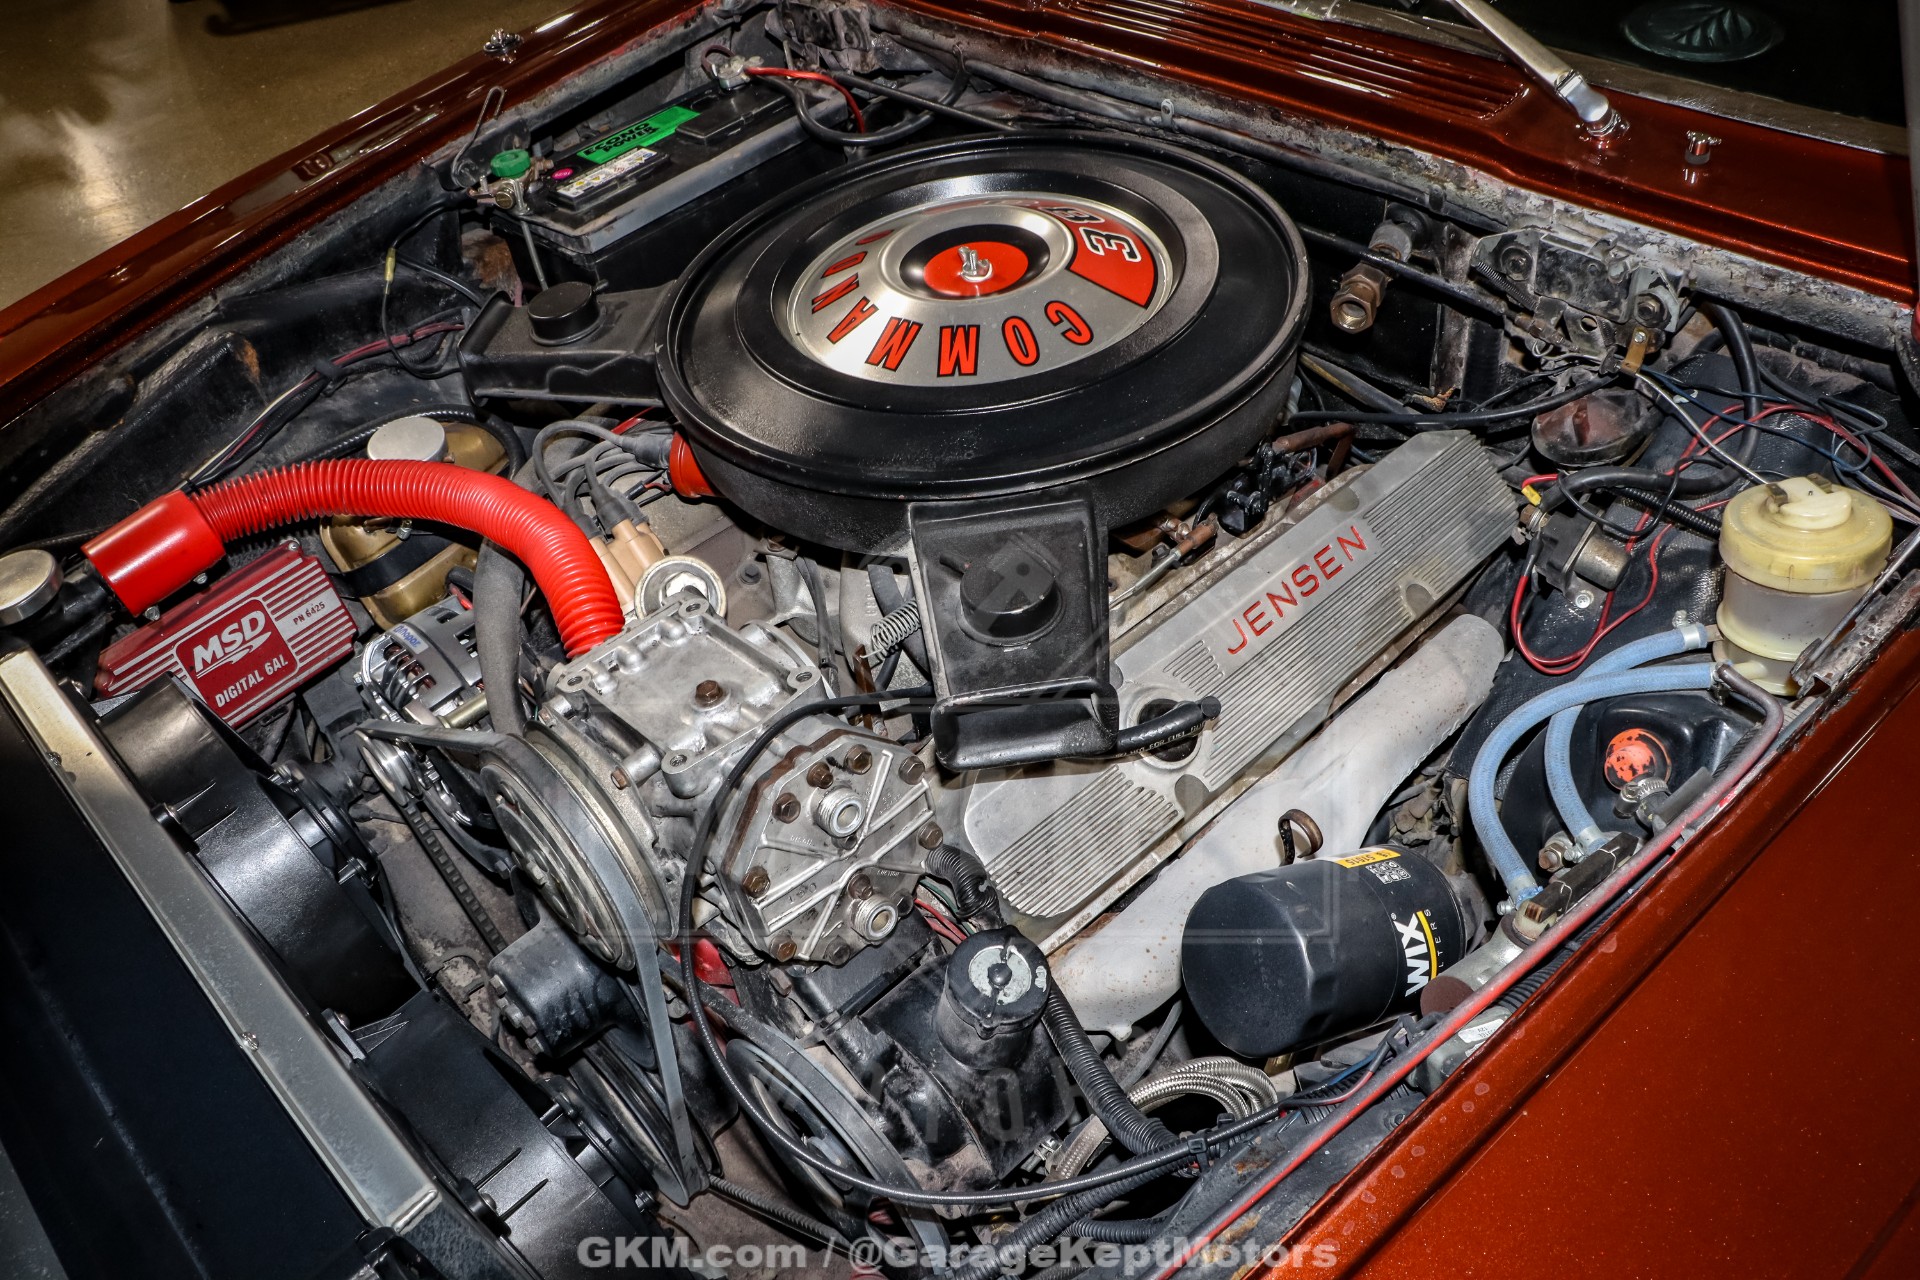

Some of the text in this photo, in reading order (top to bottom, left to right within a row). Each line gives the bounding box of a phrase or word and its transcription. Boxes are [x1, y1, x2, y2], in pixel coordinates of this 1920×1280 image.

[583, 122, 650, 156] ECONO
[603, 127, 660, 152] POWER
[1020, 203, 1141, 262] 38
[811, 229, 1094, 378] COMMANDO
[293, 602, 325, 625] PN 6425
[1227, 525, 1367, 655] JENSEN
[193, 610, 267, 673] MSD
[215, 654, 289, 708] DIGITAL 6AL
[1393, 912, 1430, 998] WIX
[1424, 908, 1445, 968] LTERS
